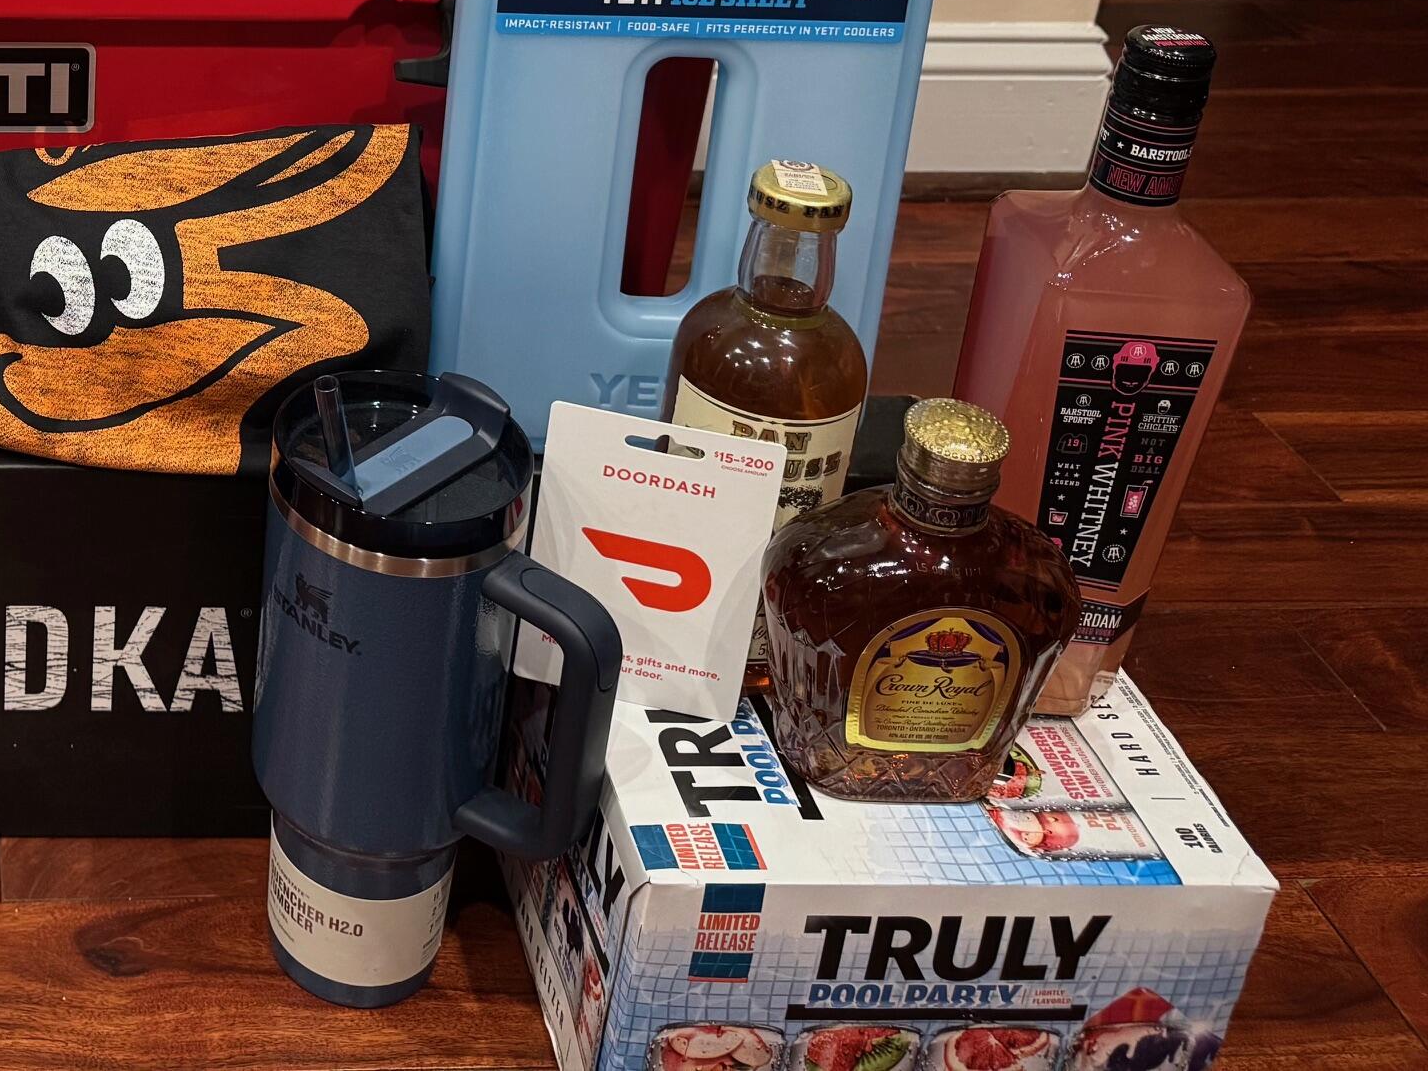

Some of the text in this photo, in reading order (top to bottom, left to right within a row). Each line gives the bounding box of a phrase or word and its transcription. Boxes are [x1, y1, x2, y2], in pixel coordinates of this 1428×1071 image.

[505, 18, 895, 37] IMPACT-RESISTANT FOOD-SAFE FITS PERFECTLY IN YETI COOLERS
[1106, 164, 1146, 193] NEW
[1060, 407, 1102, 418] BARSTOOL
[1063, 415, 1093, 425] SPORTS
[1137, 422, 1179, 433] CHICLETS
[1140, 437, 1166, 447] NOT
[1057, 462, 1082, 470] WHAT
[1130, 465, 1161, 475] DEAL
[1133, 454, 1163, 465] BIG
[603, 464, 717, 500] DOORDASH
[1049, 479, 1081, 487] LEGEND
[1069, 400, 1136, 568] PINK WHITNEY
[635, 669, 664, 681] door.
[636, 656, 663, 669] gifts
[664, 663, 686, 674] and
[688, 668, 720, 681] more,
[875, 673, 992, 700] Crown Royal
[1041, 726, 1080, 769] SPLASH
[1111, 732, 1160, 776] HARD
[741, 742, 800, 806] POOL
[1025, 724, 1085, 800] STRAWBERRY
[1070, 770, 1101, 798] KIWI
[665, 823, 701, 870] LIMITED
[687, 822, 727, 870] RELEASE
[1174, 827, 1205, 849] 100
[698, 914, 761, 931] LIMITED
[694, 931, 757, 952] RELEASE
[804, 915, 1113, 981] TRULY
[807, 982, 1023, 1007] POOL PARTY
